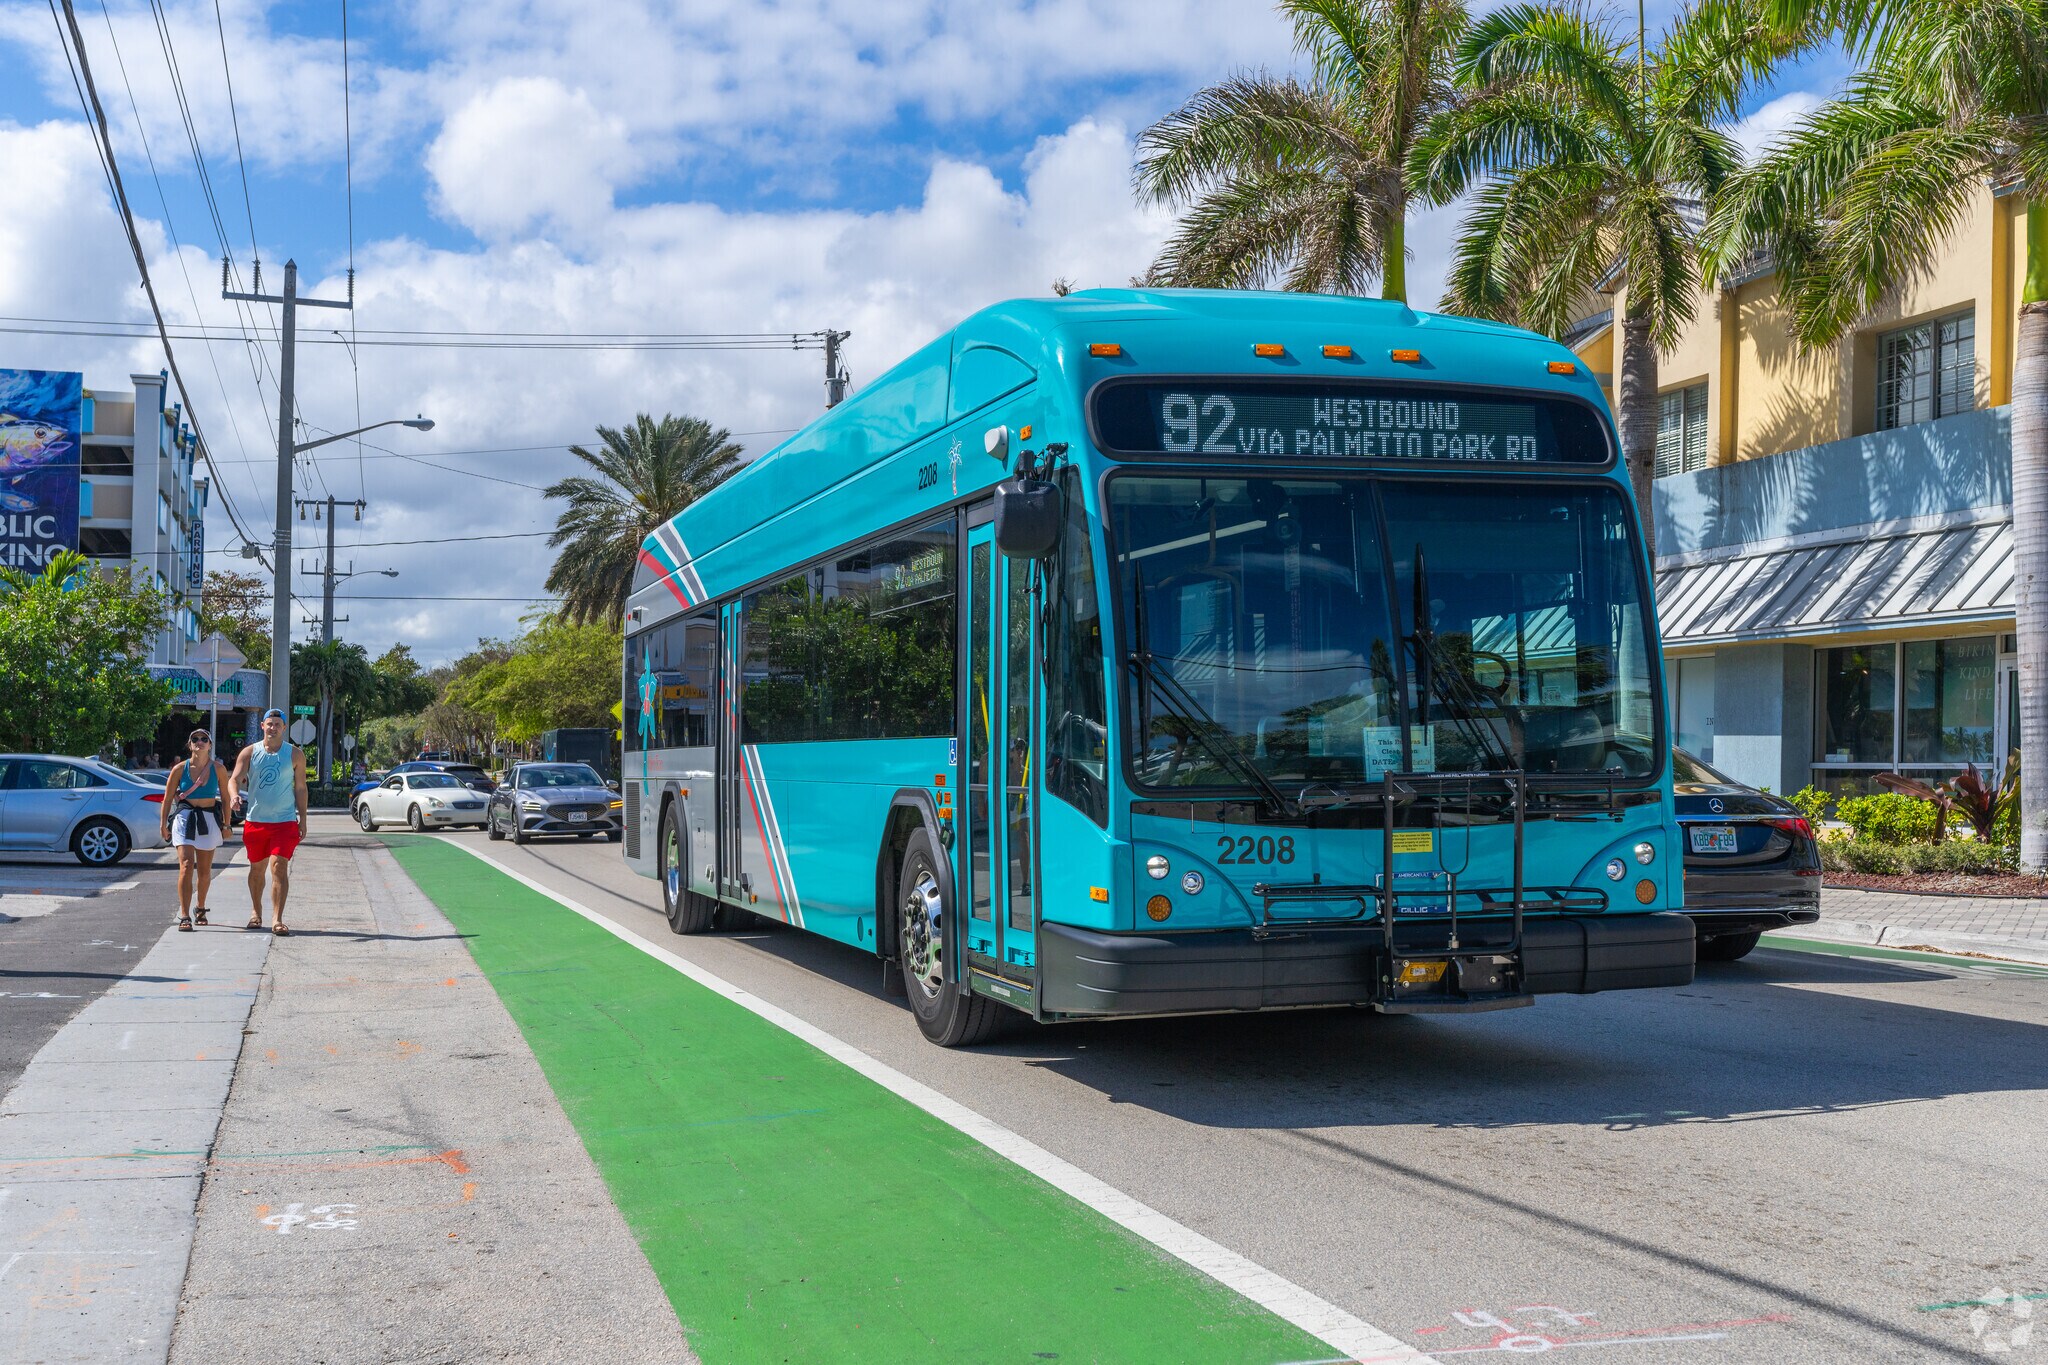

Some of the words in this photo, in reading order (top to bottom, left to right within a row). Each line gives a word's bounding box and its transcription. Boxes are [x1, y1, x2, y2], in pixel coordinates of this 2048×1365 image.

[1163, 393, 1236, 453] 92
[1314, 398, 1459, 430] WESTBOUND
[1239, 428, 1284, 454] VIA
[1296, 429, 1422, 458] PALMETTO
[1433, 433, 1496, 460] PARK
[1507, 435, 1537, 461] RD
[918, 461, 938, 491] 2208
[192, 522, 201, 579] PARKING
[1959, 666, 1995, 680] KIND
[1964, 687, 1993, 701] LIFE
[1217, 835, 1296, 865] 2208
[1400, 906, 1428, 914] GILLIG
